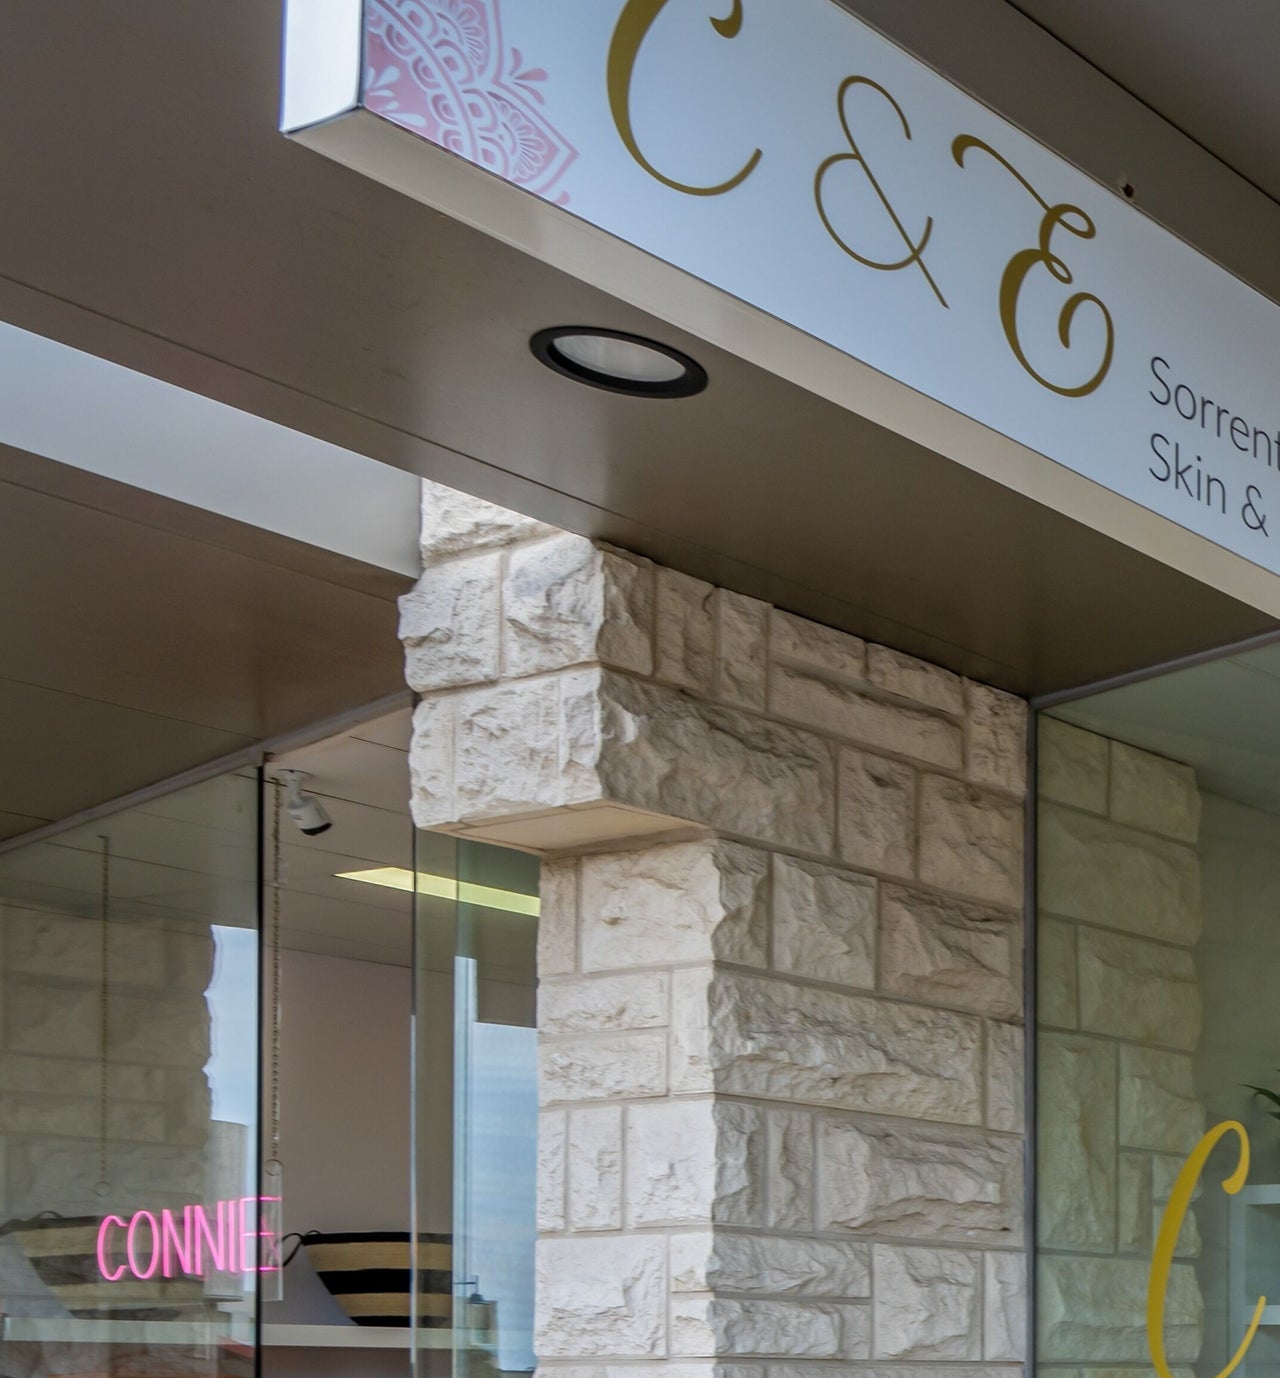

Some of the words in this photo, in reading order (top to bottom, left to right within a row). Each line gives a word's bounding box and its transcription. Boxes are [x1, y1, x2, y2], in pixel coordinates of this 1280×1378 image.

[606, 0, 763, 197] C
[813, 75, 951, 310] &
[951, 133, 1115, 398] E
[1148, 432, 1226, 515] Skin
[1241, 484, 1269, 538] &
[97, 1196, 282, 1281] CONNIE
